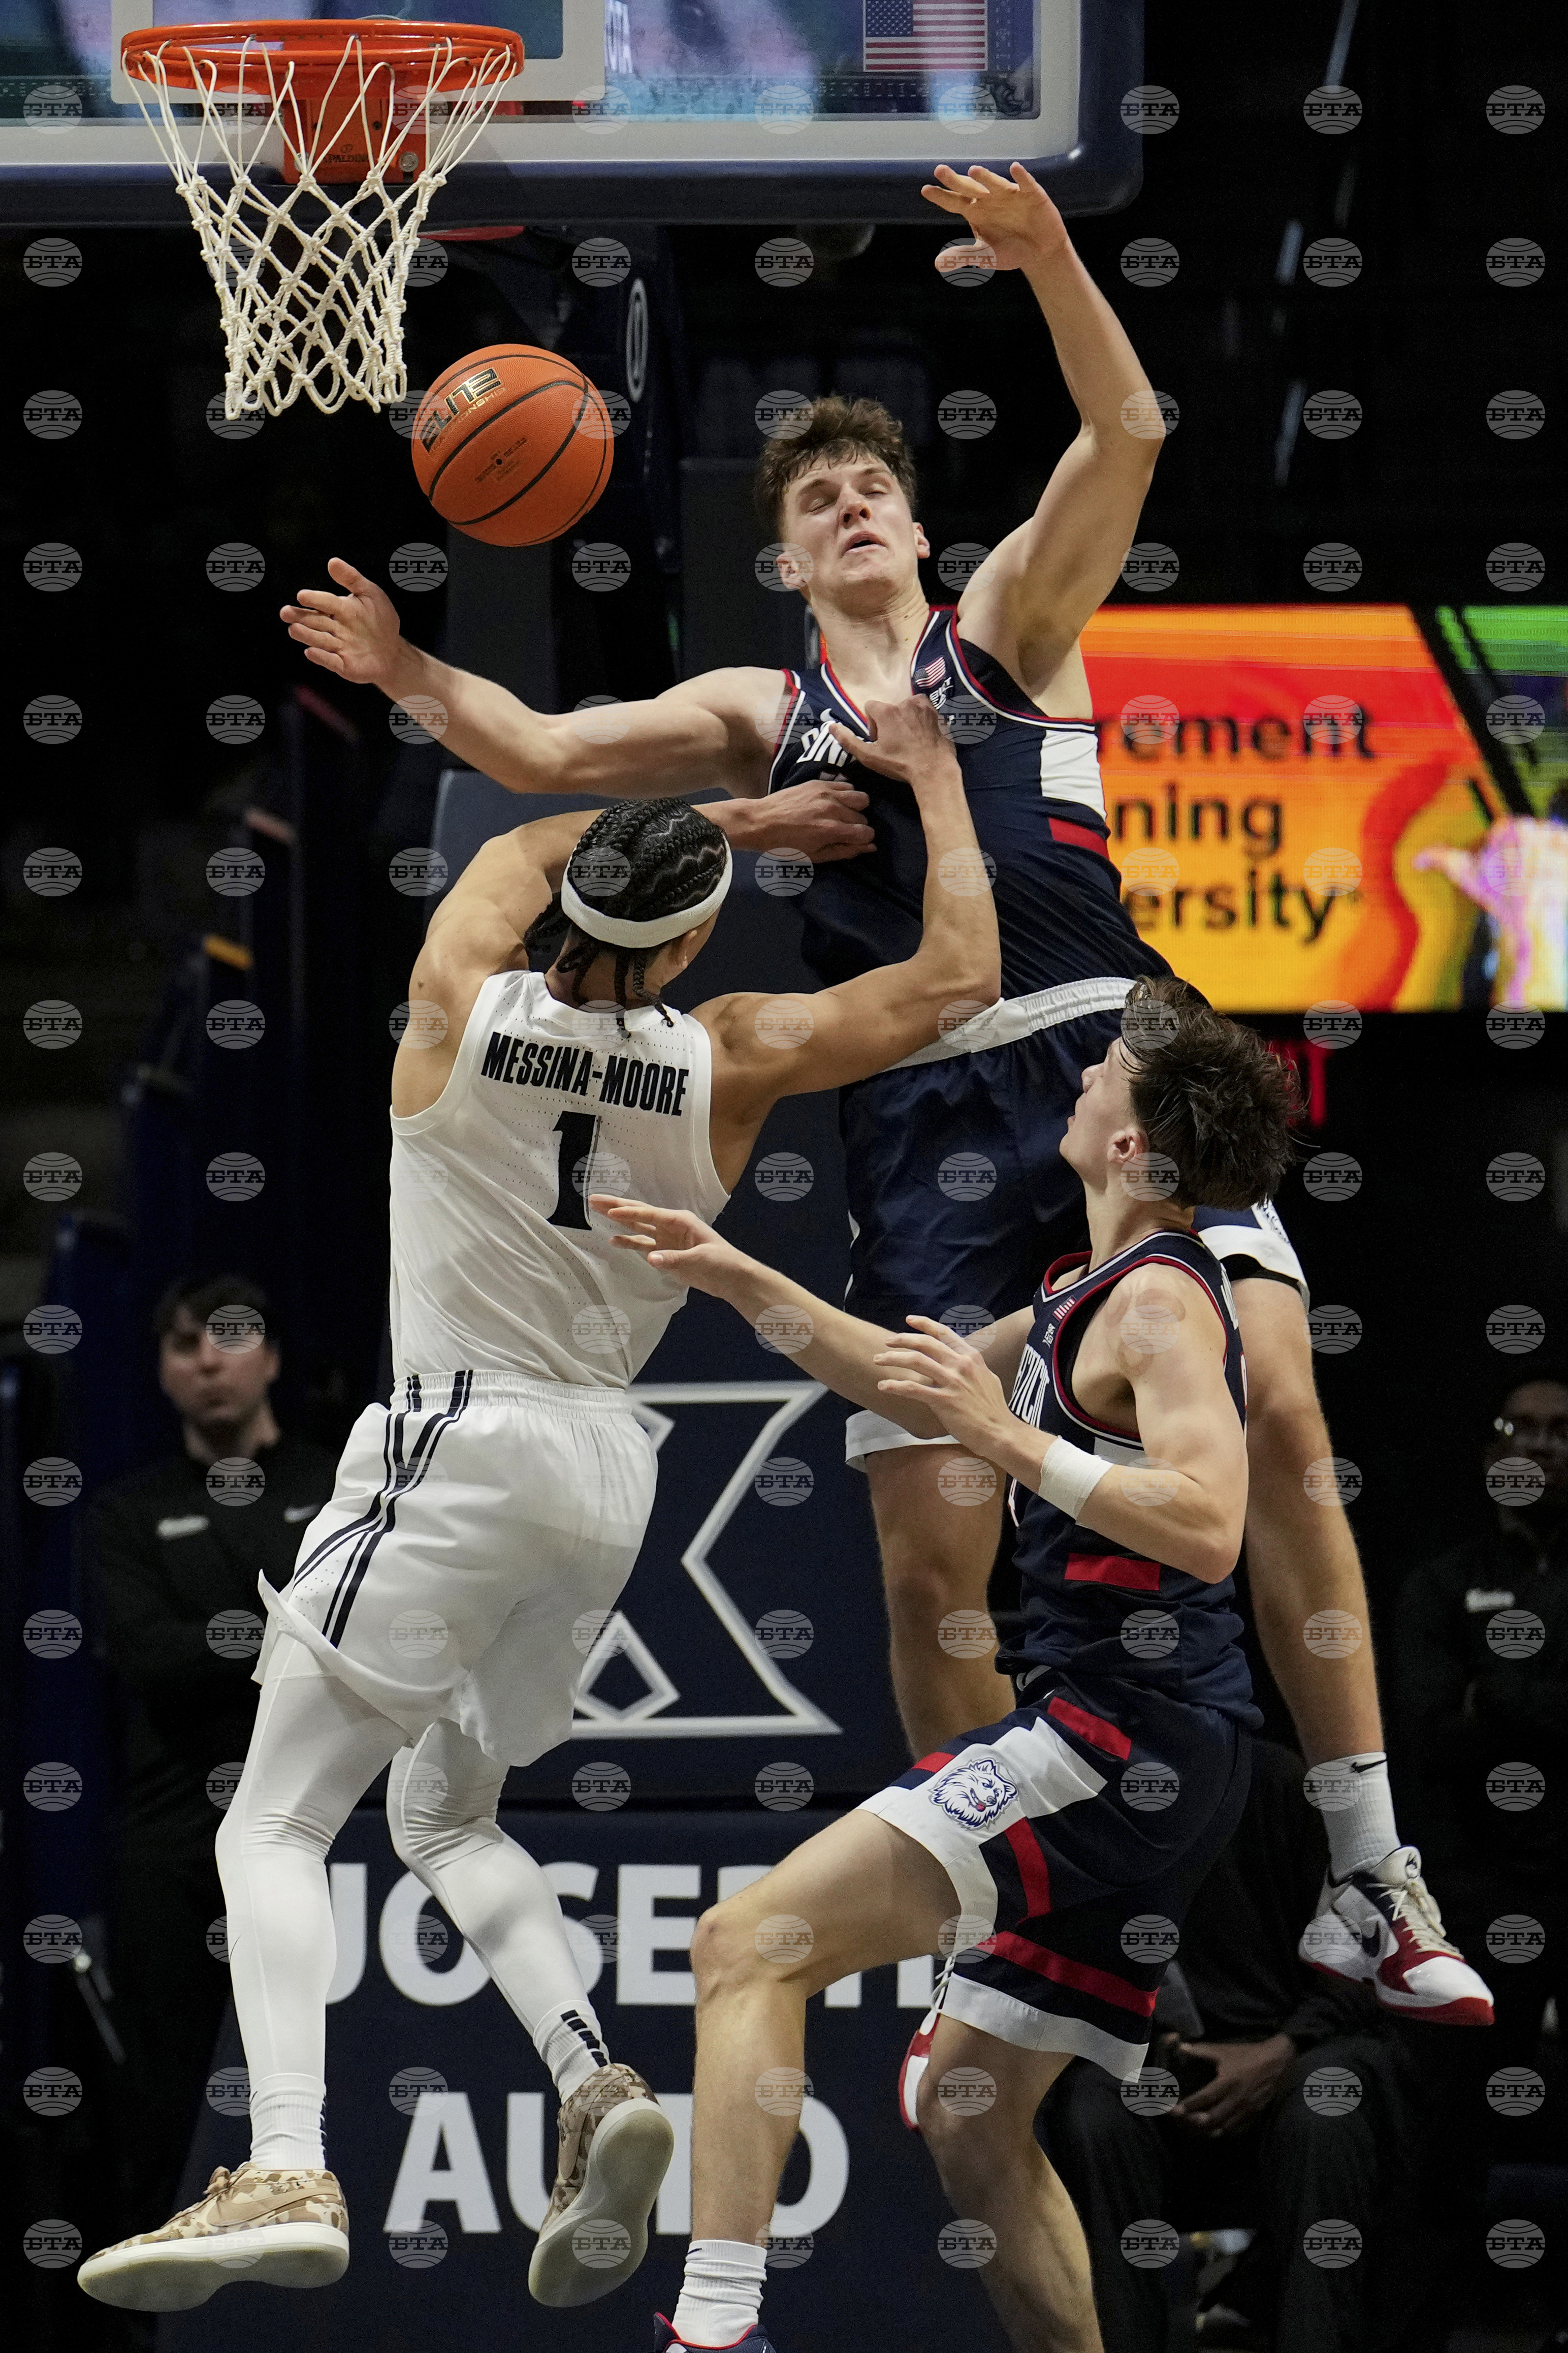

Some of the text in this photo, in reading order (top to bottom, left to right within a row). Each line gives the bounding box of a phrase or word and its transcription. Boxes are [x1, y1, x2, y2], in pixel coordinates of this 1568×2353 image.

[1112, 781, 1284, 859] ning
[481, 1031, 689, 1116] MESSINA-MOORE
[547, 1111, 601, 1231] 1
